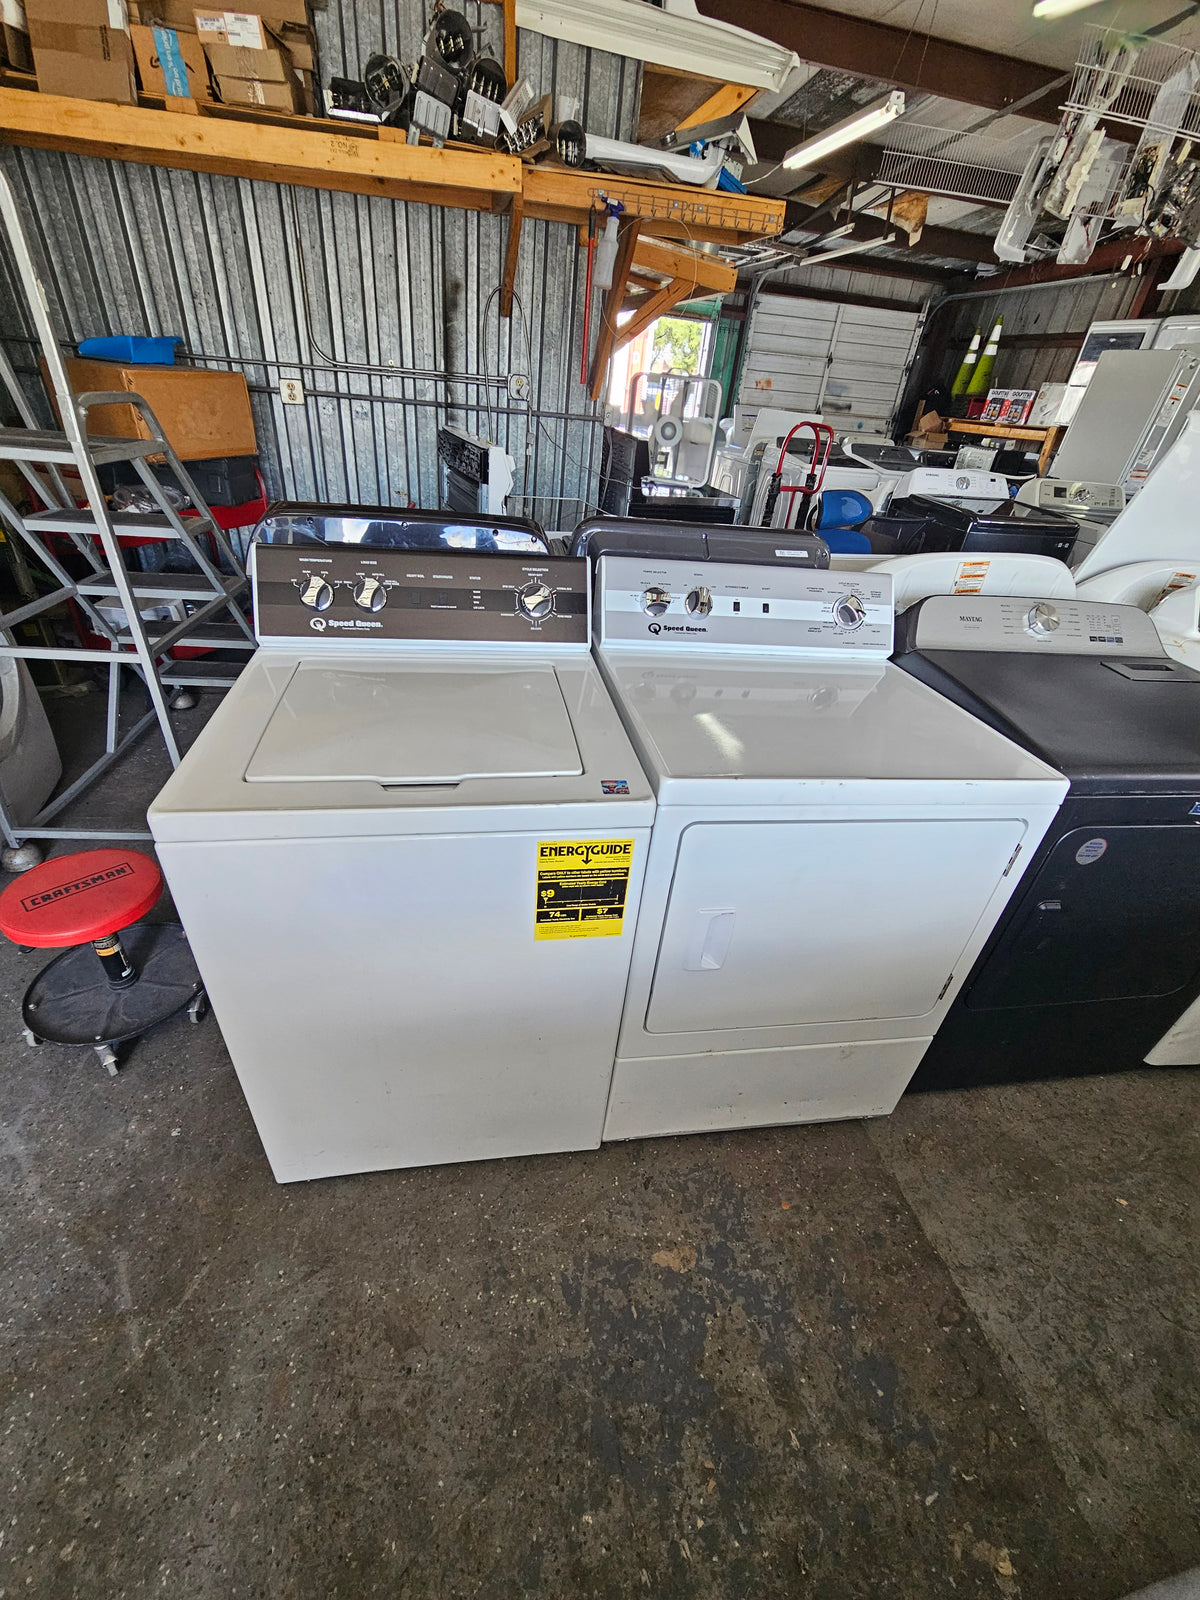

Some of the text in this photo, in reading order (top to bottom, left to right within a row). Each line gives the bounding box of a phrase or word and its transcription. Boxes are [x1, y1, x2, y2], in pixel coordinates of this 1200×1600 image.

[328, 619, 355, 628] Speed
[540, 844, 632, 858] ENERGYGUIDE
[30, 866, 128, 906] CRAFTSMAN
[541, 889, 555, 898] $9
